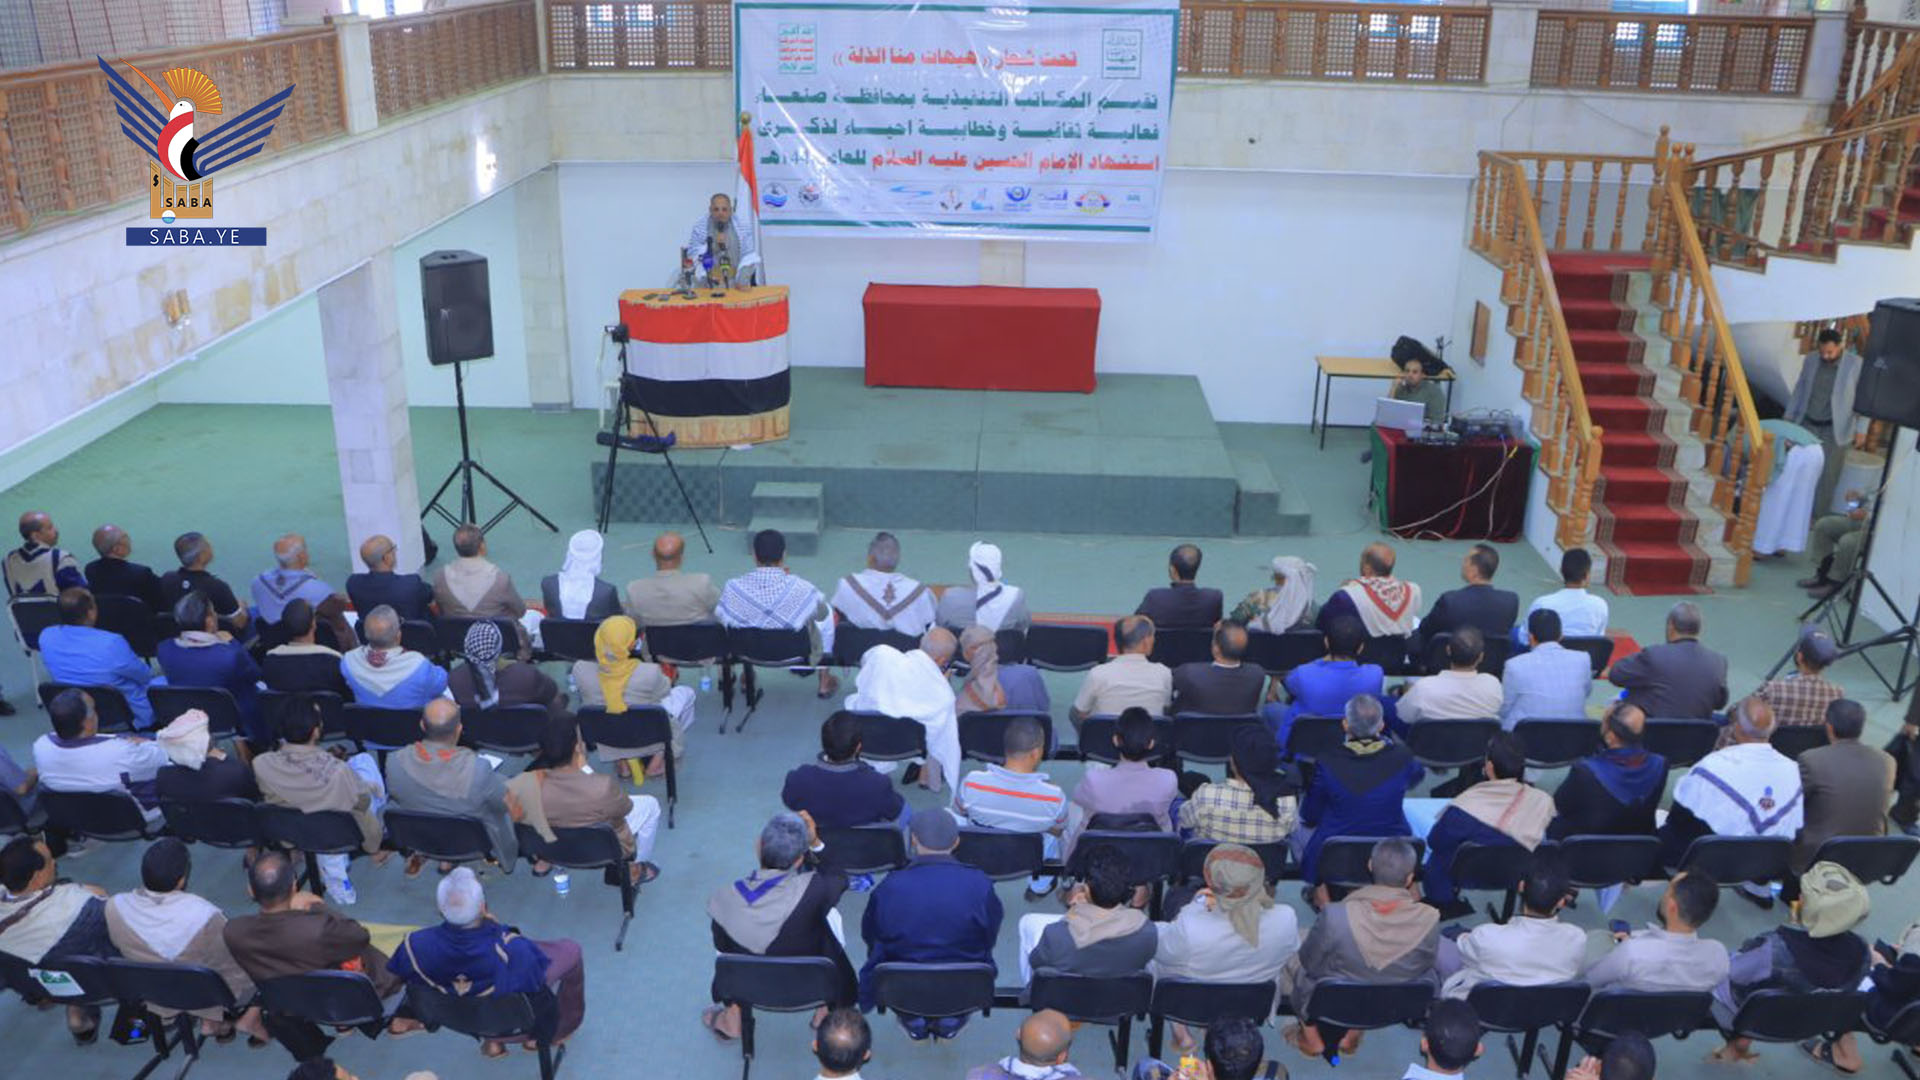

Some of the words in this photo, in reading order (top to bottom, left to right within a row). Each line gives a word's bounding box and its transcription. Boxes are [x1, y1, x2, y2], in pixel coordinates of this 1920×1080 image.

[848, 45, 886, 64] الذلة
[889, 47, 916, 64] منا
[920, 48, 977, 68] هيهات
[992, 48, 1035, 70] شعار
[1040, 49, 1078, 67] تحت
[755, 86, 827, 105] صنعاء
[832, 85, 916, 109] بمحافظة
[1014, 90, 1092, 112] المكاتب
[1097, 92, 1159, 114] تقيم
[918, 117, 1008, 142] وخطابية
[1011, 120, 1082, 142] ثقافية
[1087, 120, 1160, 144] فعالية
[871, 149, 923, 171] السلام
[928, 150, 968, 171] عليه
[1088, 153, 1160, 172] استشهاد
